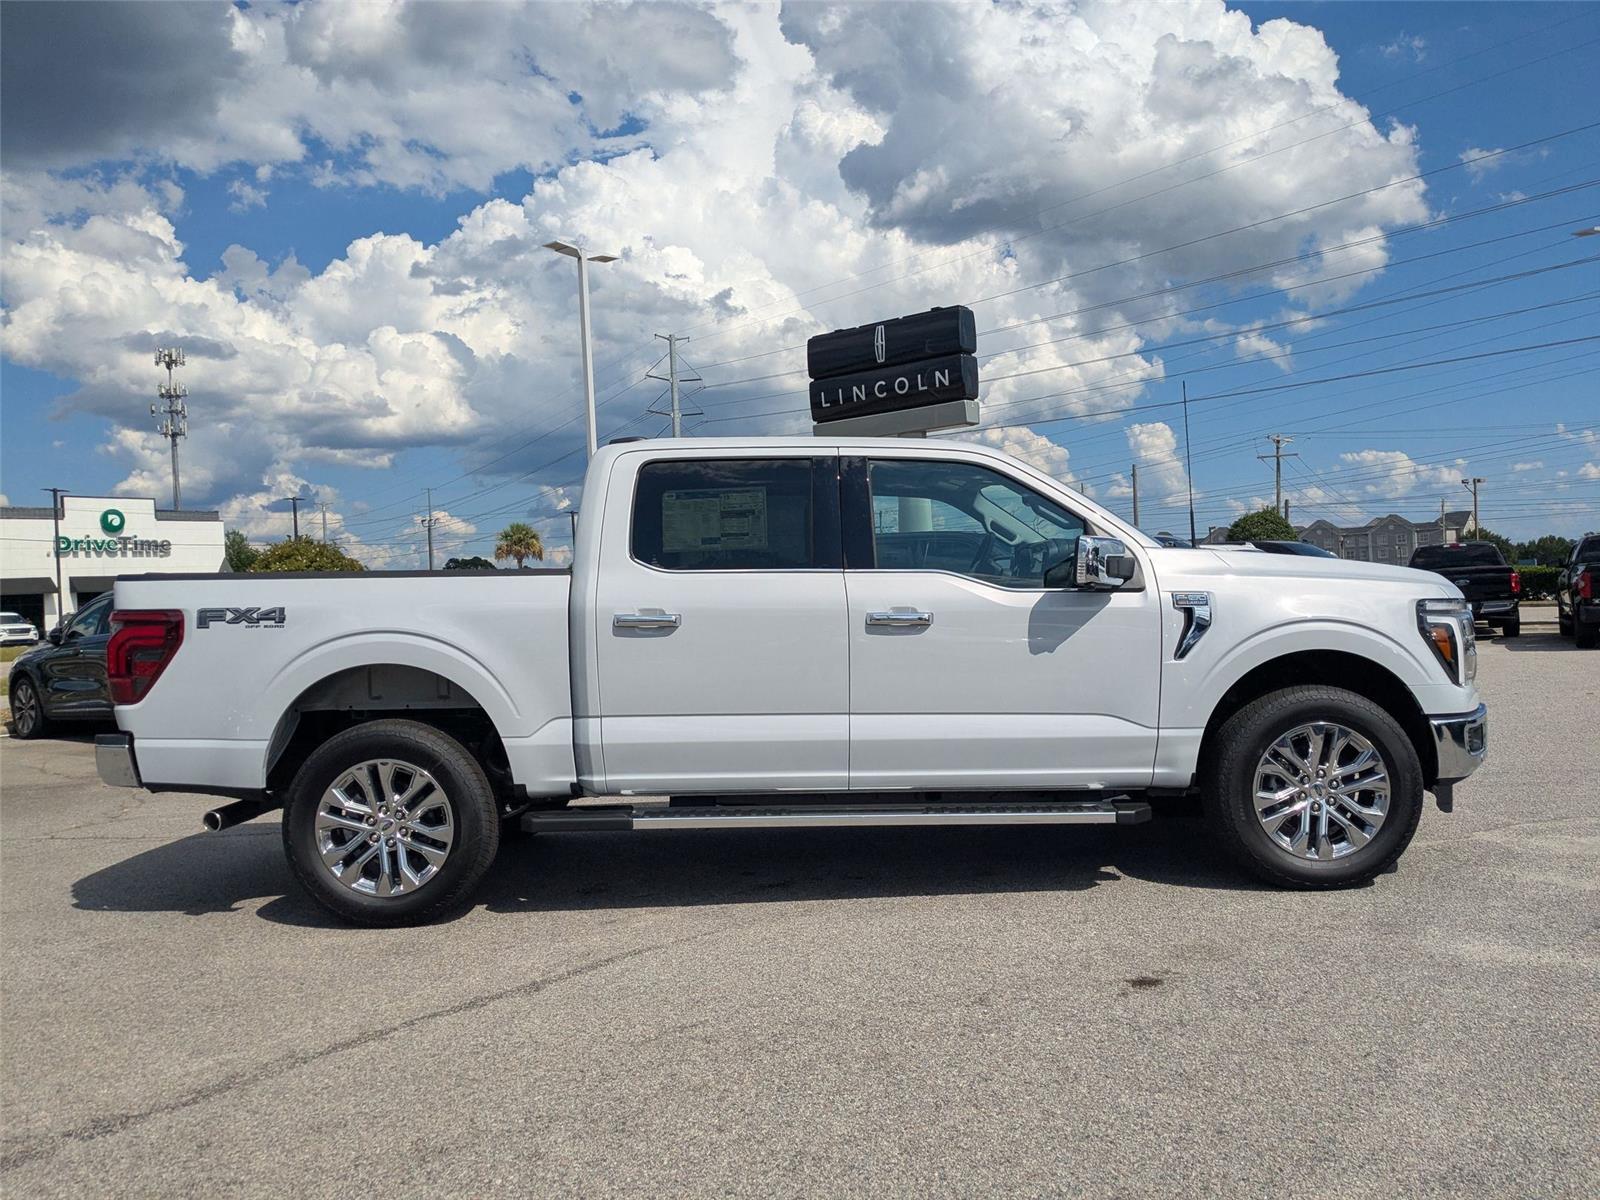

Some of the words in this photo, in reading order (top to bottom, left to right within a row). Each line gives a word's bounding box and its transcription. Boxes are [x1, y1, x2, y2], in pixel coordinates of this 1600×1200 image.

[821, 369, 950, 408] LINCOLN
[57, 534, 172, 552] DriveTime
[196, 606, 287, 629] FX4
